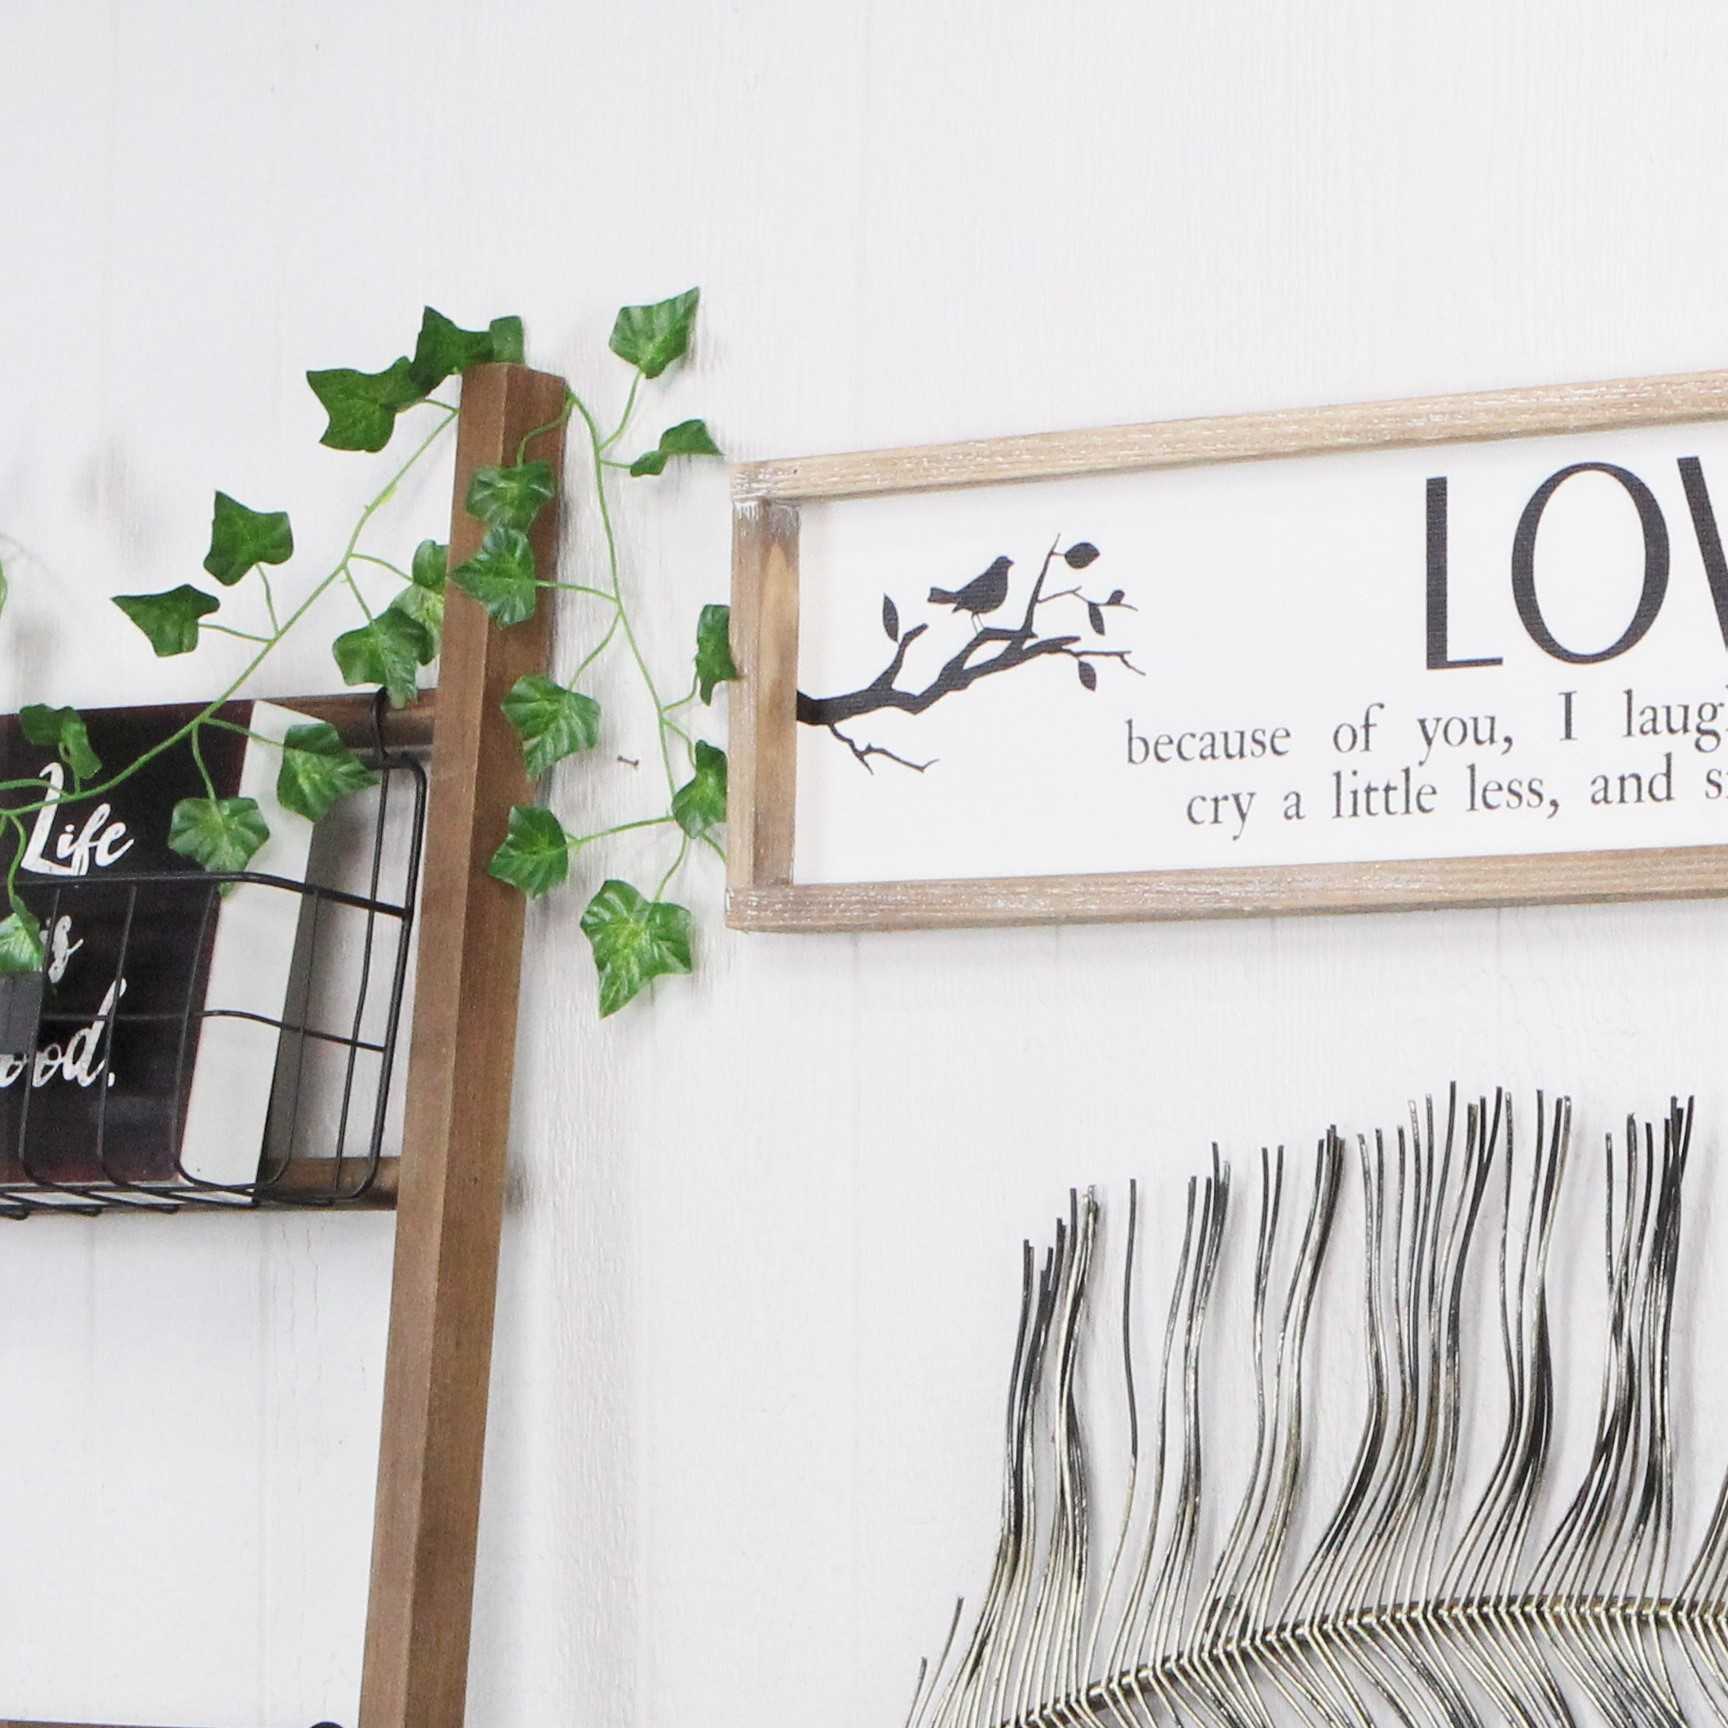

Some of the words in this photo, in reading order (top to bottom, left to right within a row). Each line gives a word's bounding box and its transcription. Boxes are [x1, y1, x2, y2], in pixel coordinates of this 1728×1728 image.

[1125, 718, 1292, 765] because
[1332, 702, 1386, 752] of
[1416, 714, 1514, 767] you,
[1557, 690, 1579, 741] I
[20, 761, 135, 876] Life
[1186, 788, 1257, 841] cry
[1283, 789, 1307, 820] a
[1332, 766, 1439, 819] little
[1466, 763, 1560, 819] less,
[1589, 752, 1676, 805] and
